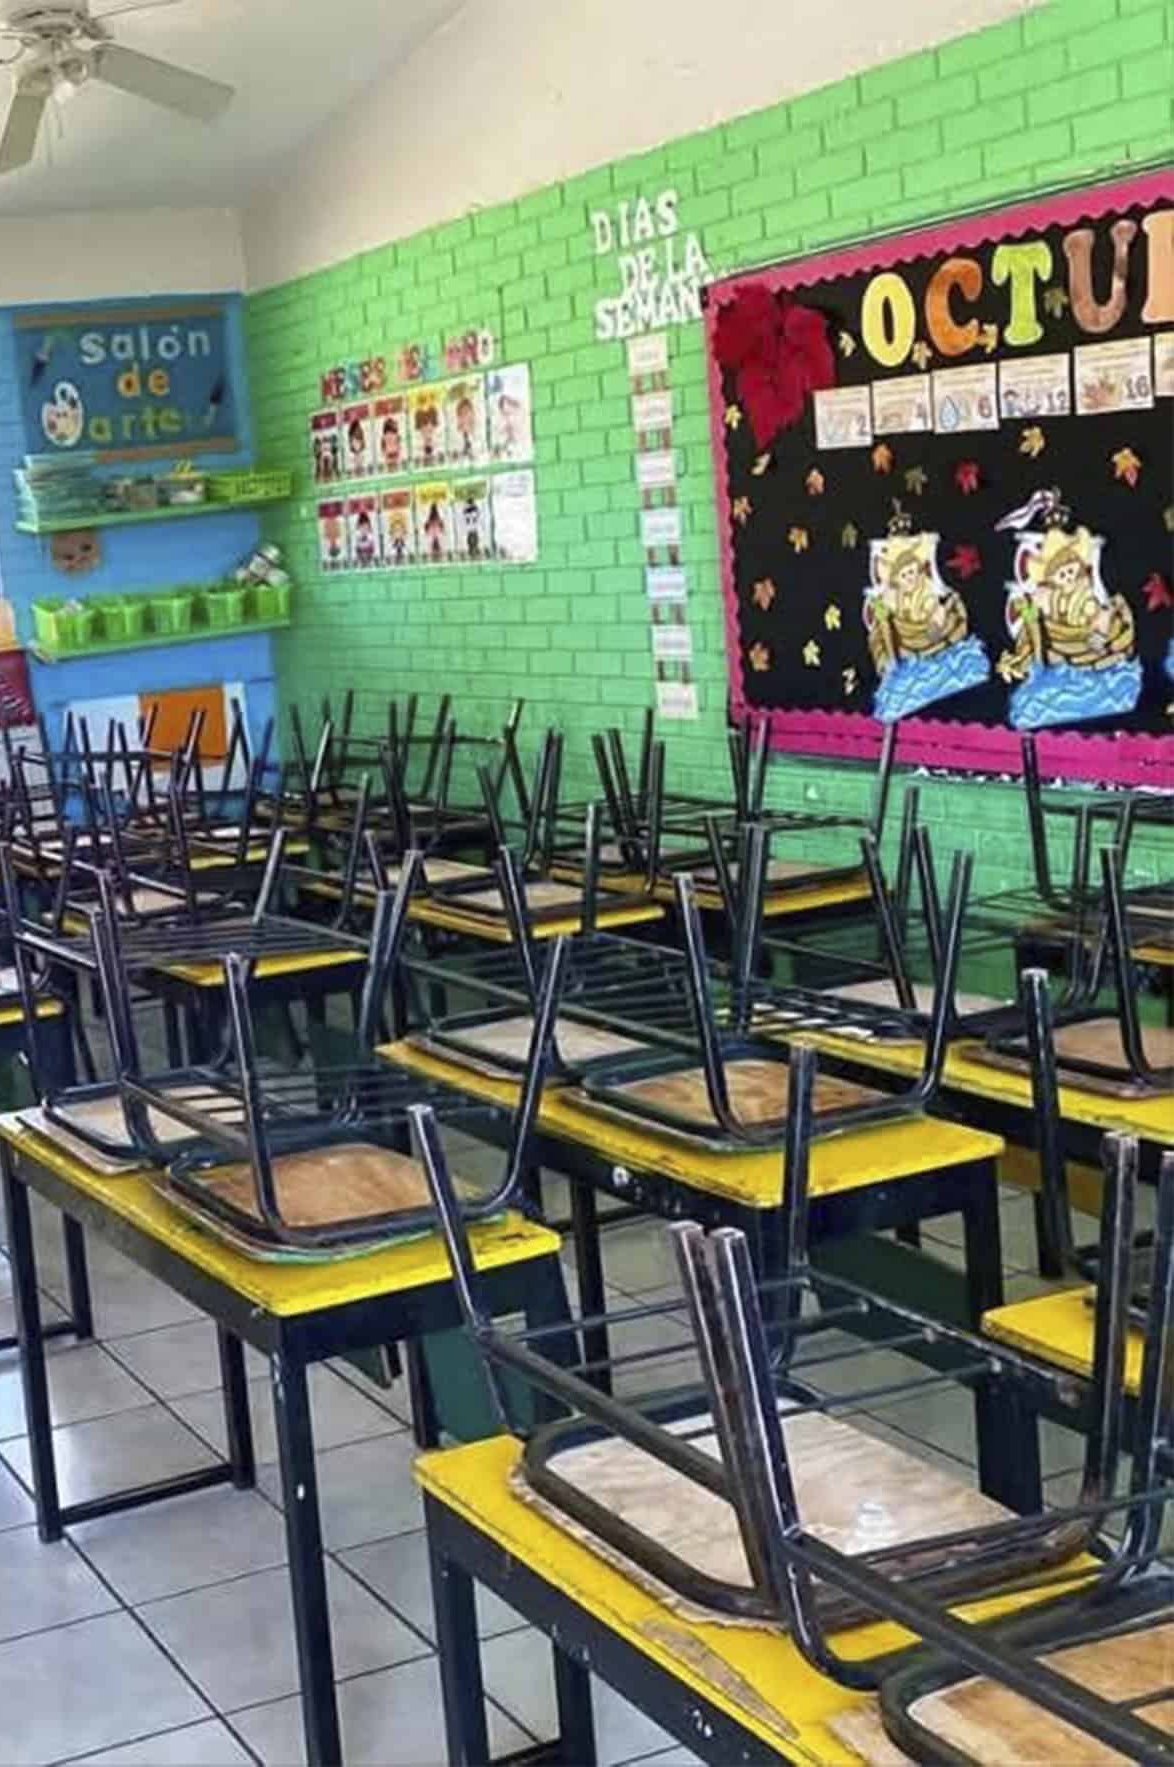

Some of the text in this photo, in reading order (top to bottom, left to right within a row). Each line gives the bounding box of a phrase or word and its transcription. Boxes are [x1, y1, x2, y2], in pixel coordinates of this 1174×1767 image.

[619, 234, 708, 292] DE LA
[117, 363, 170, 397] de
[89, 407, 186, 442] arte
